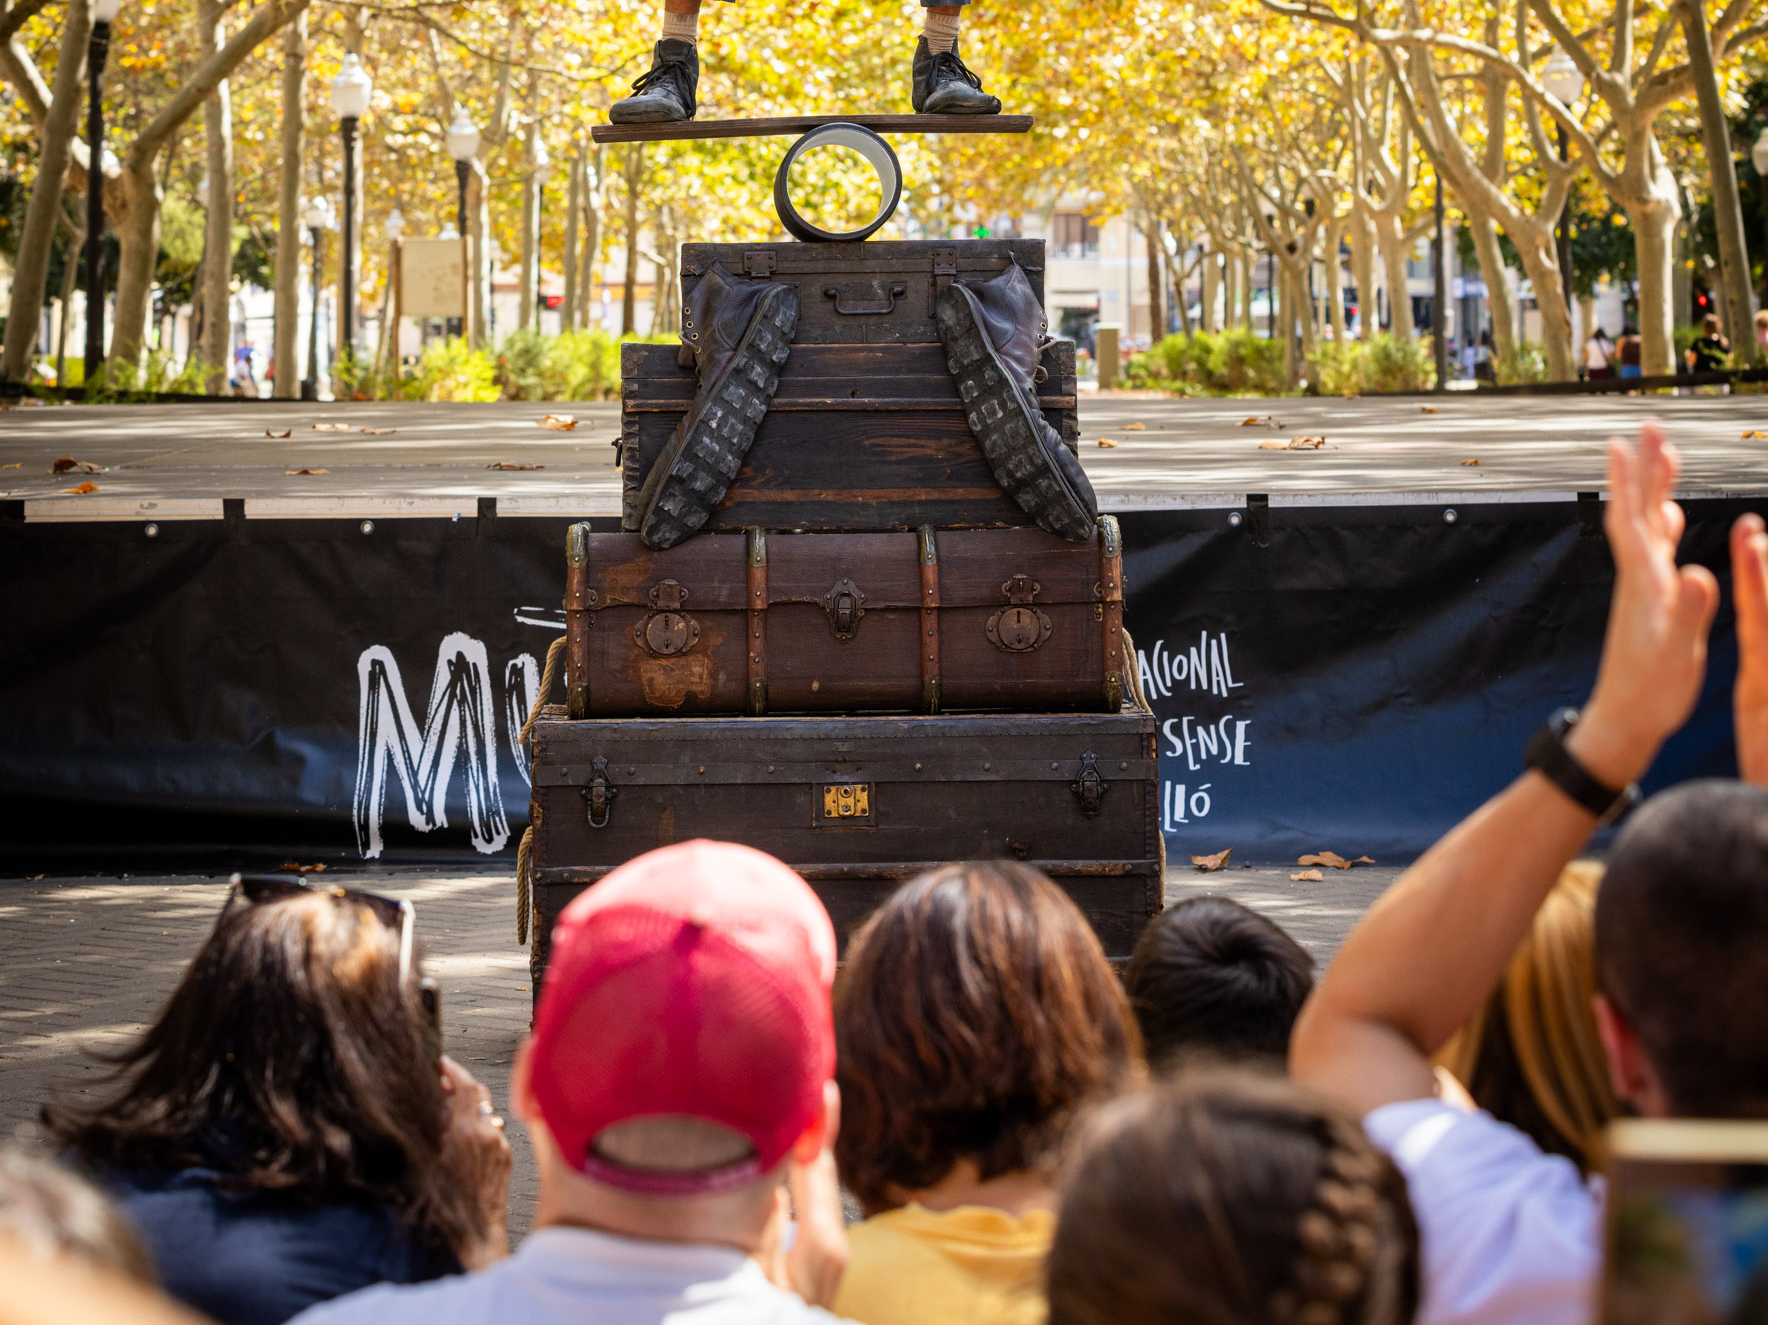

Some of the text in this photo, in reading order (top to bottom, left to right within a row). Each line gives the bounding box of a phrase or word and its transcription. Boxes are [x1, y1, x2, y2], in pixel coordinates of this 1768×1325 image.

[1123, 630, 1244, 700] ACIONAL
[1162, 714, 1252, 771] SENSE
[1158, 780, 1212, 833] LLÓ
